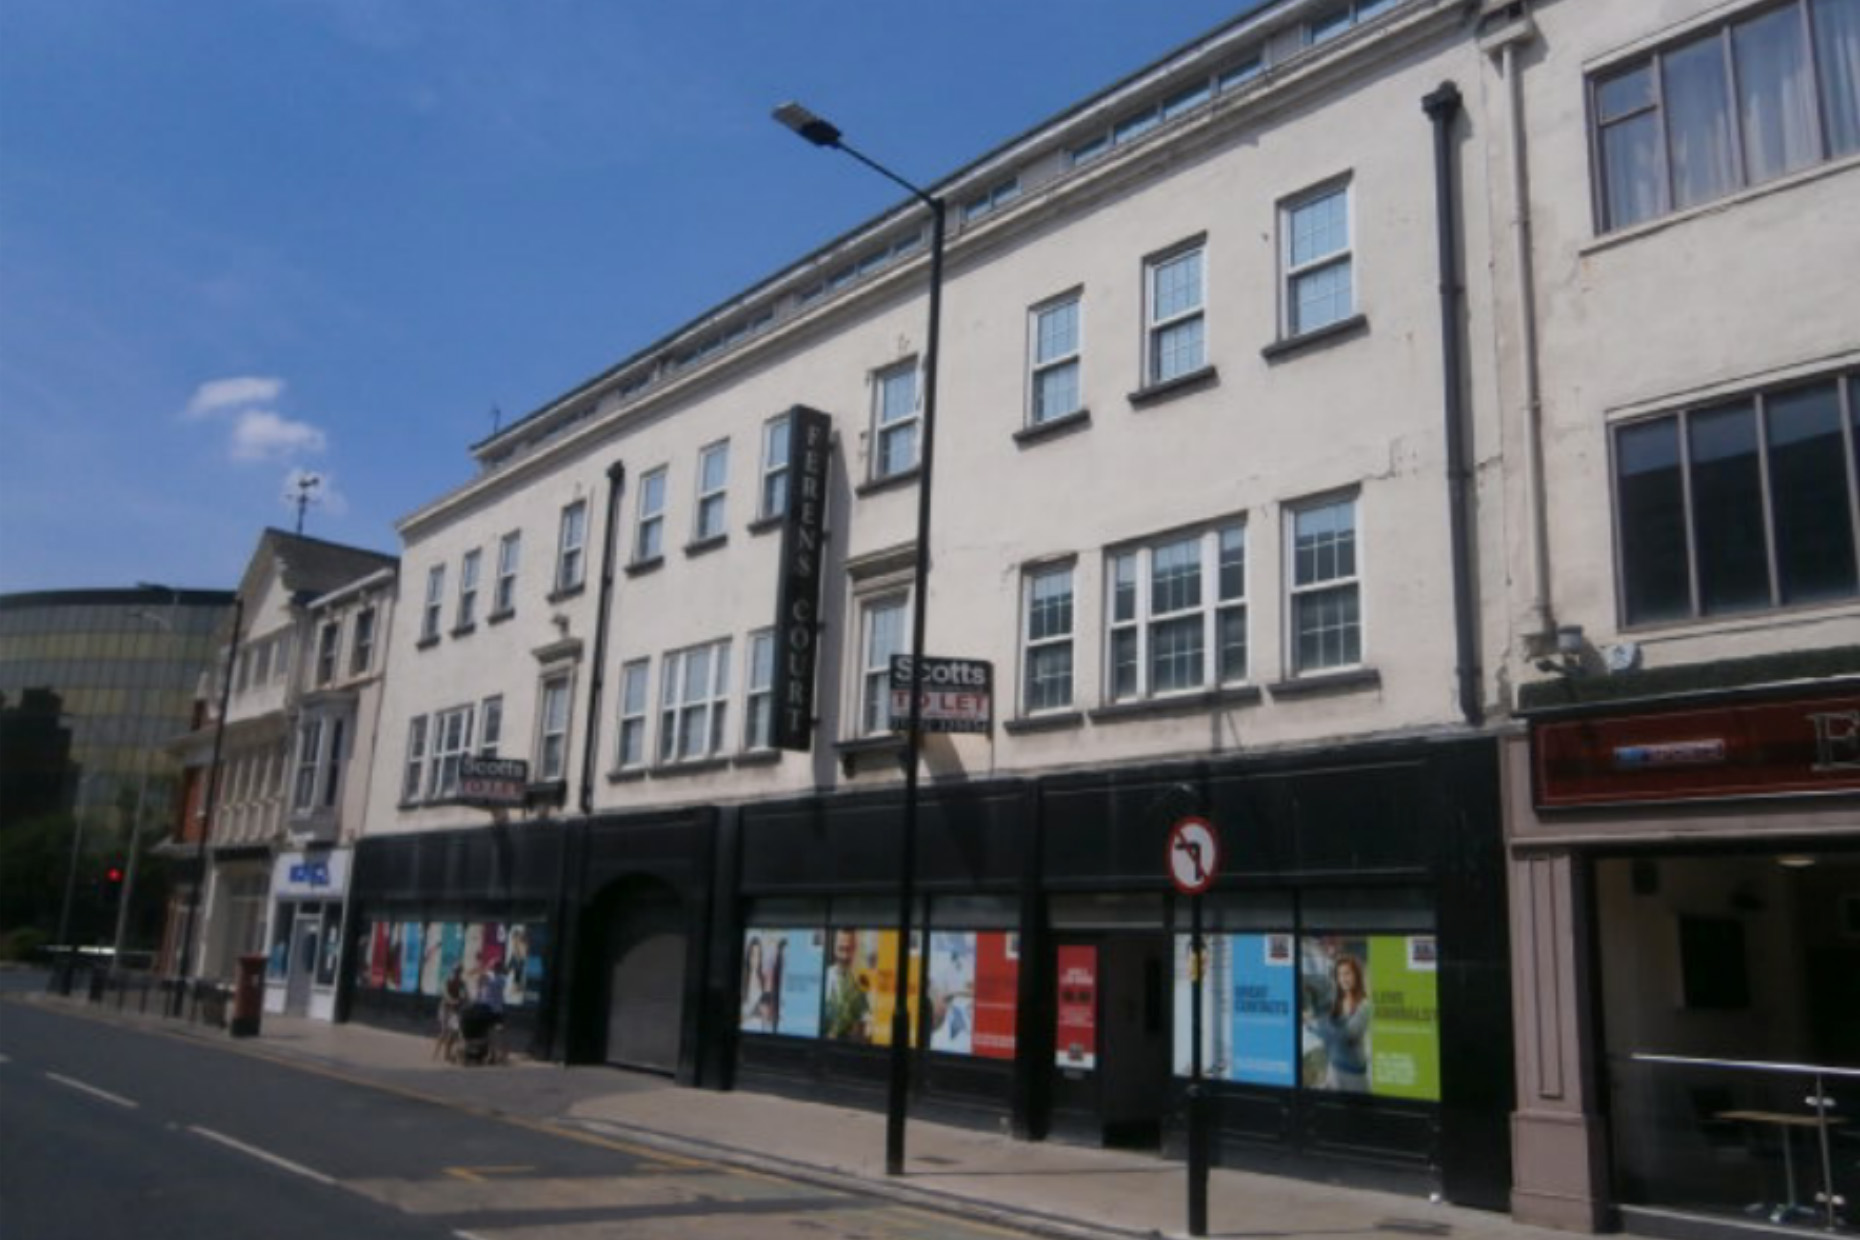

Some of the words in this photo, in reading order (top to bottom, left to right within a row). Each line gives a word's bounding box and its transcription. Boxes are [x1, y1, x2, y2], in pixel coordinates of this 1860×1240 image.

[797, 423, 822, 579] FERENS
[787, 598, 810, 733] COURT
[895, 658, 985, 685] Scotts
